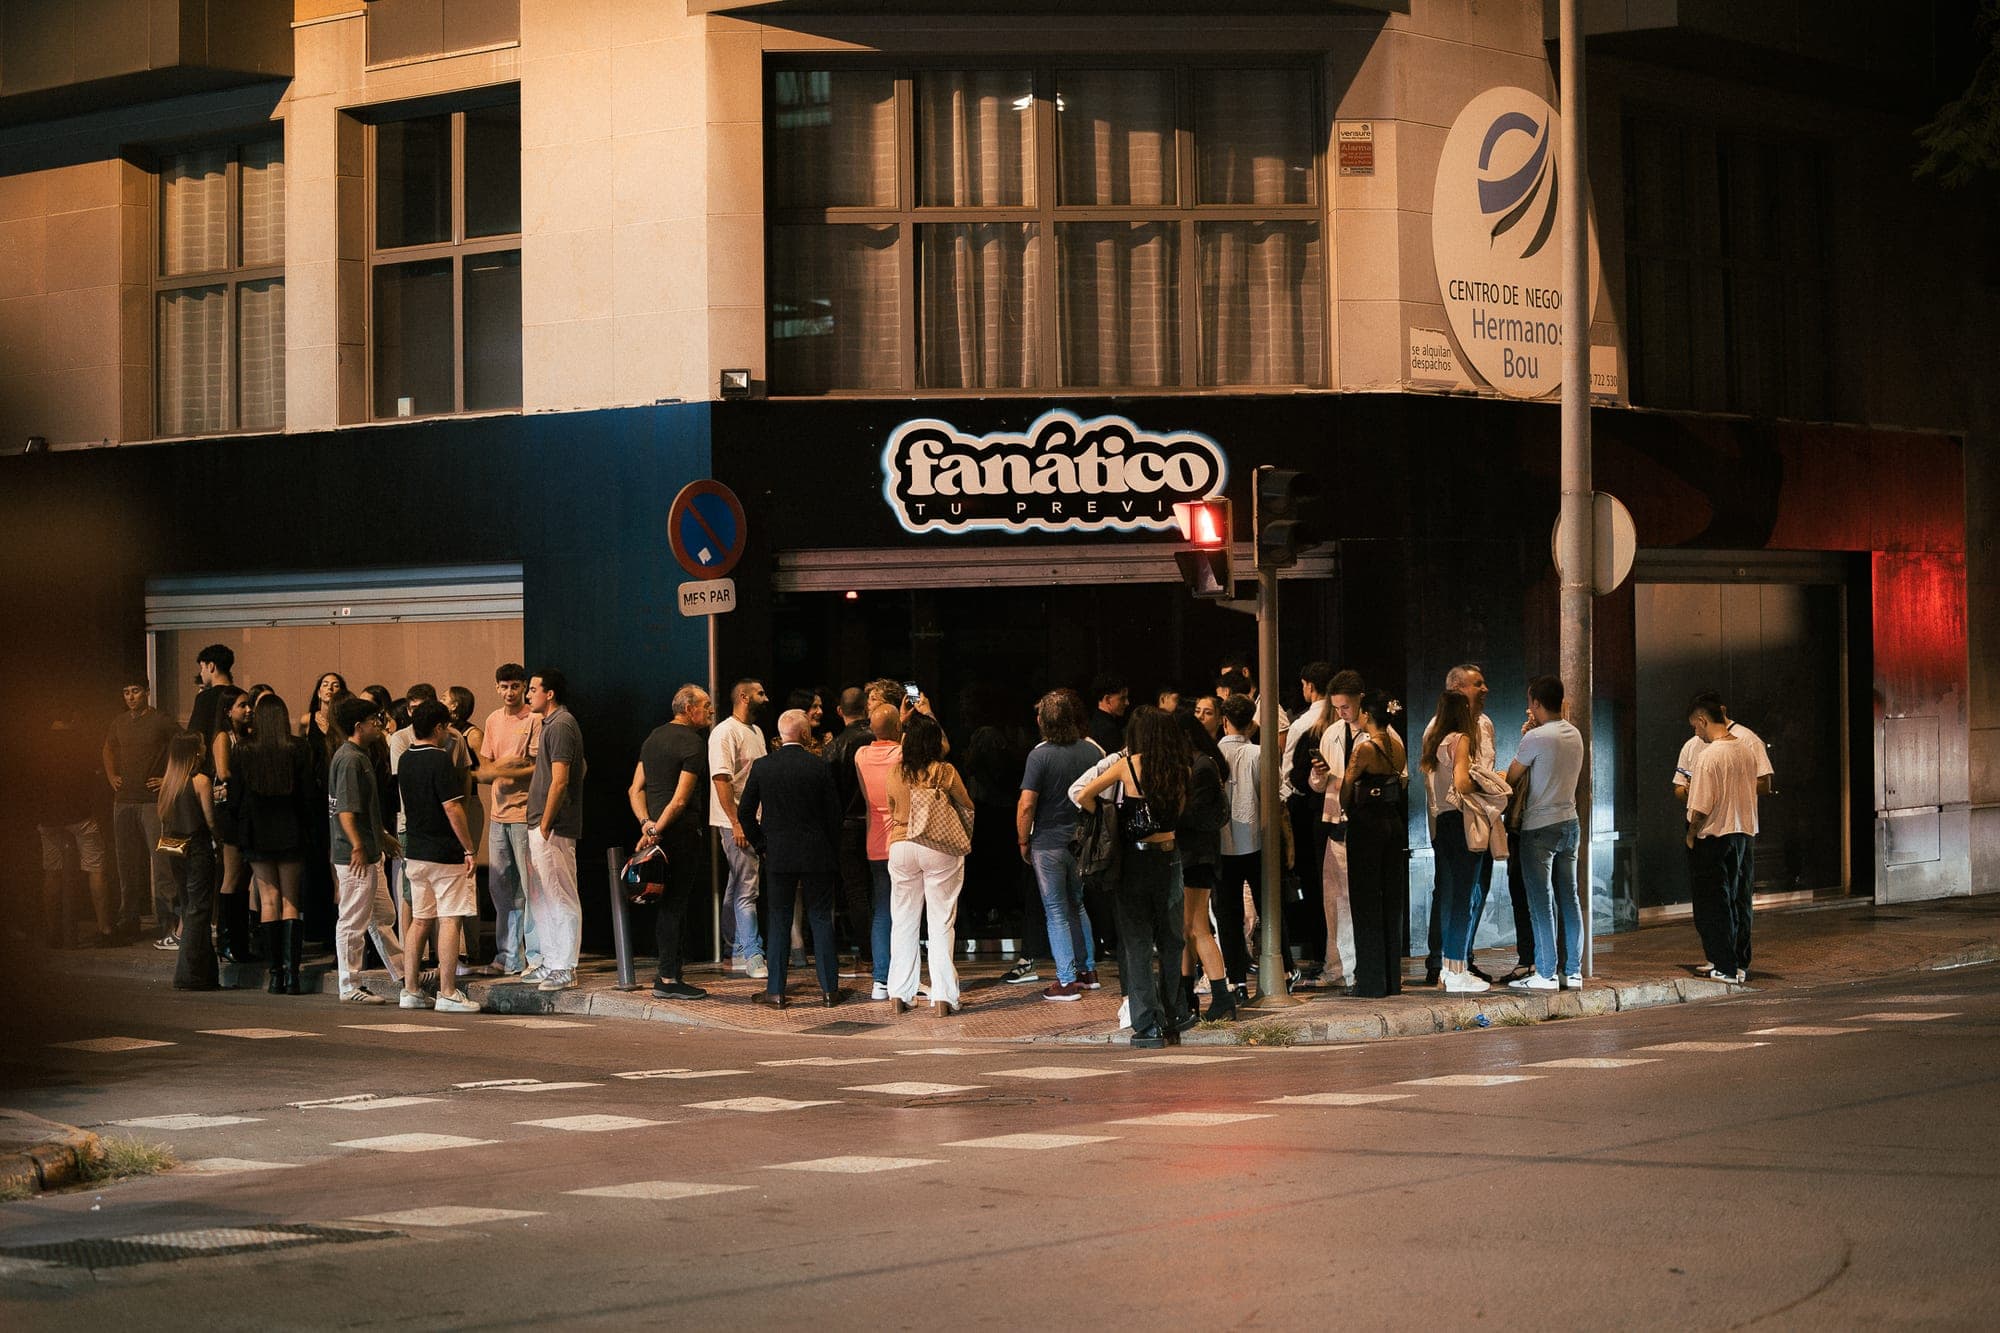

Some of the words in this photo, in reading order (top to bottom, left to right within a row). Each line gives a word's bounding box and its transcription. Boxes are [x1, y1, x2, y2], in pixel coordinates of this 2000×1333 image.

[1449, 280, 1500, 304] CENTRO
[1503, 285, 1519, 305] DE
[1526, 287, 1562, 310] NEGO
[1411, 345, 1420, 356] se
[1422, 344, 1452, 359] alquilan
[1411, 356, 1452, 372] despachos
[1503, 347, 1539, 379] Bou
[1593, 373, 1605, 386] 722
[1606, 374, 1617, 387] 530
[905, 431, 1210, 496] fanático
[915, 503, 962, 516] TU
[1016, 500, 1162, 515] PREVI
[683, 591, 706, 606] MES
[710, 589, 730, 603] PAR
